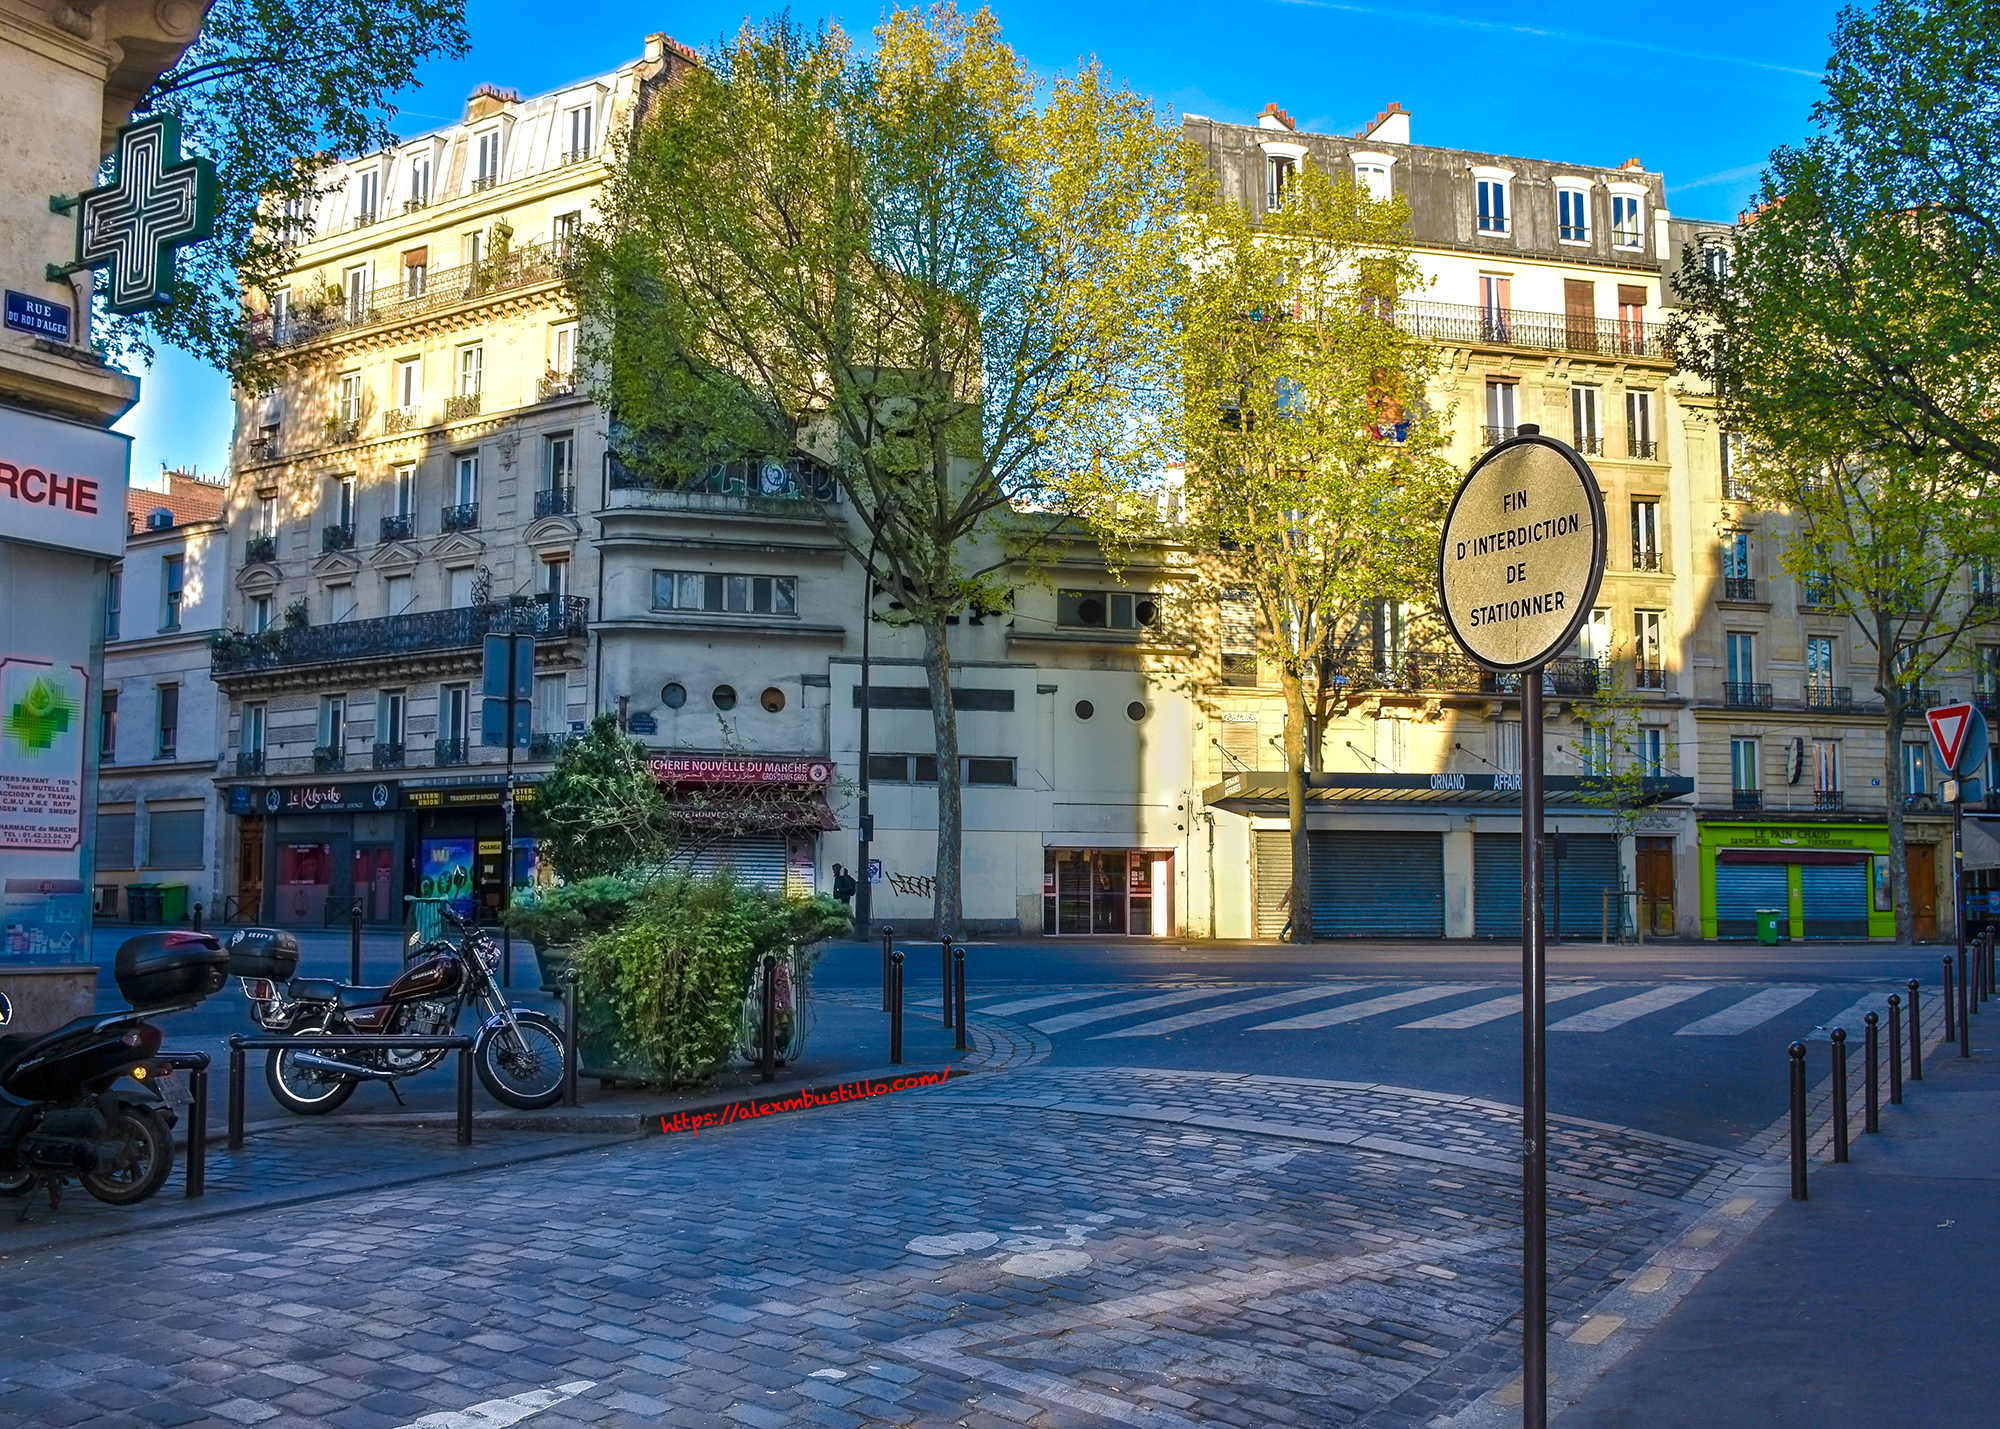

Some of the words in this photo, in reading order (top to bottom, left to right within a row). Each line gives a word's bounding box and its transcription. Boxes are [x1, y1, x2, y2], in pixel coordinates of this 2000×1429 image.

[26, 300, 51, 317] RUE
[8, 310, 18, 322] DU
[21, 314, 35, 327] ROI
[37, 317, 67, 335] D'ALGER
[1503, 489, 1527, 514] FIN
[1506, 562, 1526, 585] DE
[1470, 590, 1565, 627] STATIONNER
[641, 760, 690, 771] UCHERIE
[692, 761, 745, 772] NOUVELLE
[747, 762, 763, 772] DU
[764, 762, 809, 773] MARCHE
[21, 776, 50, 784] PAYANT
[1430, 774, 1465, 790] ORNANO
[1493, 774, 1522, 790] AFFAIR
[31, 785, 70, 793] MUTELLES
[47, 793, 77, 801] TRAVAIL
[287, 790, 299, 809] Le
[301, 786, 341, 810] Kokoriko
[409, 792, 440, 800] WESTERN
[450, 794, 476, 802] TRANSFERT
[476, 793, 500, 801] D'ARGENT
[48, 826, 78, 834] MARCHE
[1754, 829, 1766, 838] LE
[1771, 829, 1792, 839] PAIN
[1797, 830, 1830, 839] CHAUD
